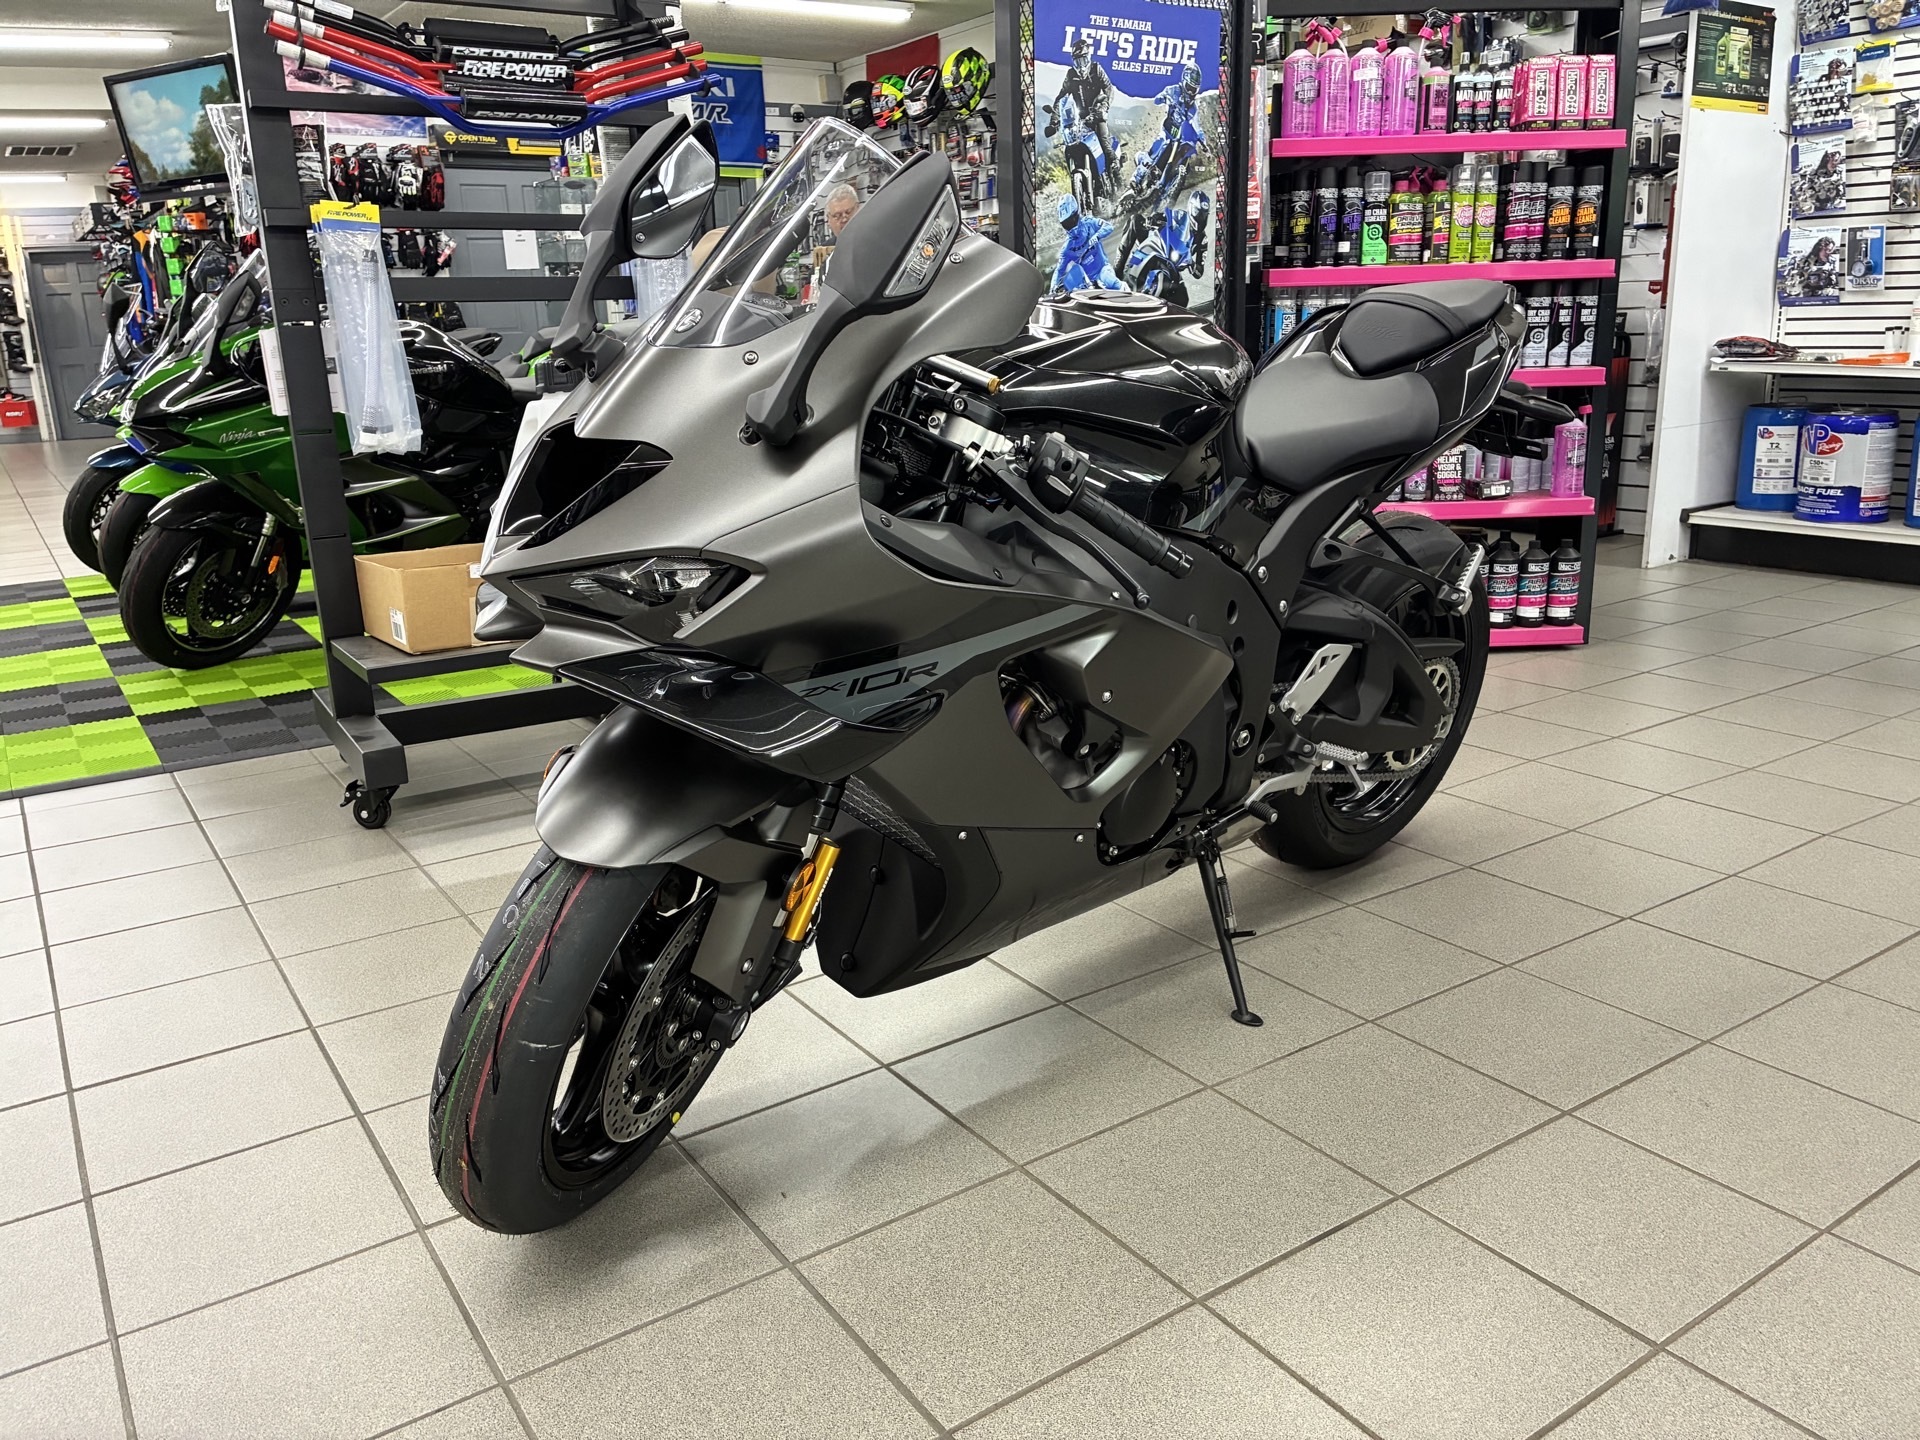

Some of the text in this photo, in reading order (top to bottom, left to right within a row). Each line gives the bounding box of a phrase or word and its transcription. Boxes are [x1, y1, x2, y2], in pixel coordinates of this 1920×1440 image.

[1090, 14, 1152, 32] THE YAMAHA
[1062, 25, 1199, 65] LET'S RIDE
[463, 59, 501, 75] FIRE
[503, 62, 568, 78] POWER
[1111, 60, 1174, 76] SALES EVENT
[458, 134, 498, 143] OPEN TRAIL
[342, 211, 367, 219] POWER
[219, 428, 256, 444] Ninja
[1804, 424, 1830, 456] VP
[1437, 455, 1462, 464] HELMET
[1438, 463, 1455, 471] VISOR
[1436, 470, 1462, 479] GOGGLE
[1815, 486, 1844, 496] FUEL
[1527, 577, 1542, 585] AIR
[1557, 577, 1572, 585] AIR
[799, 661, 939, 698] ZX-10R
